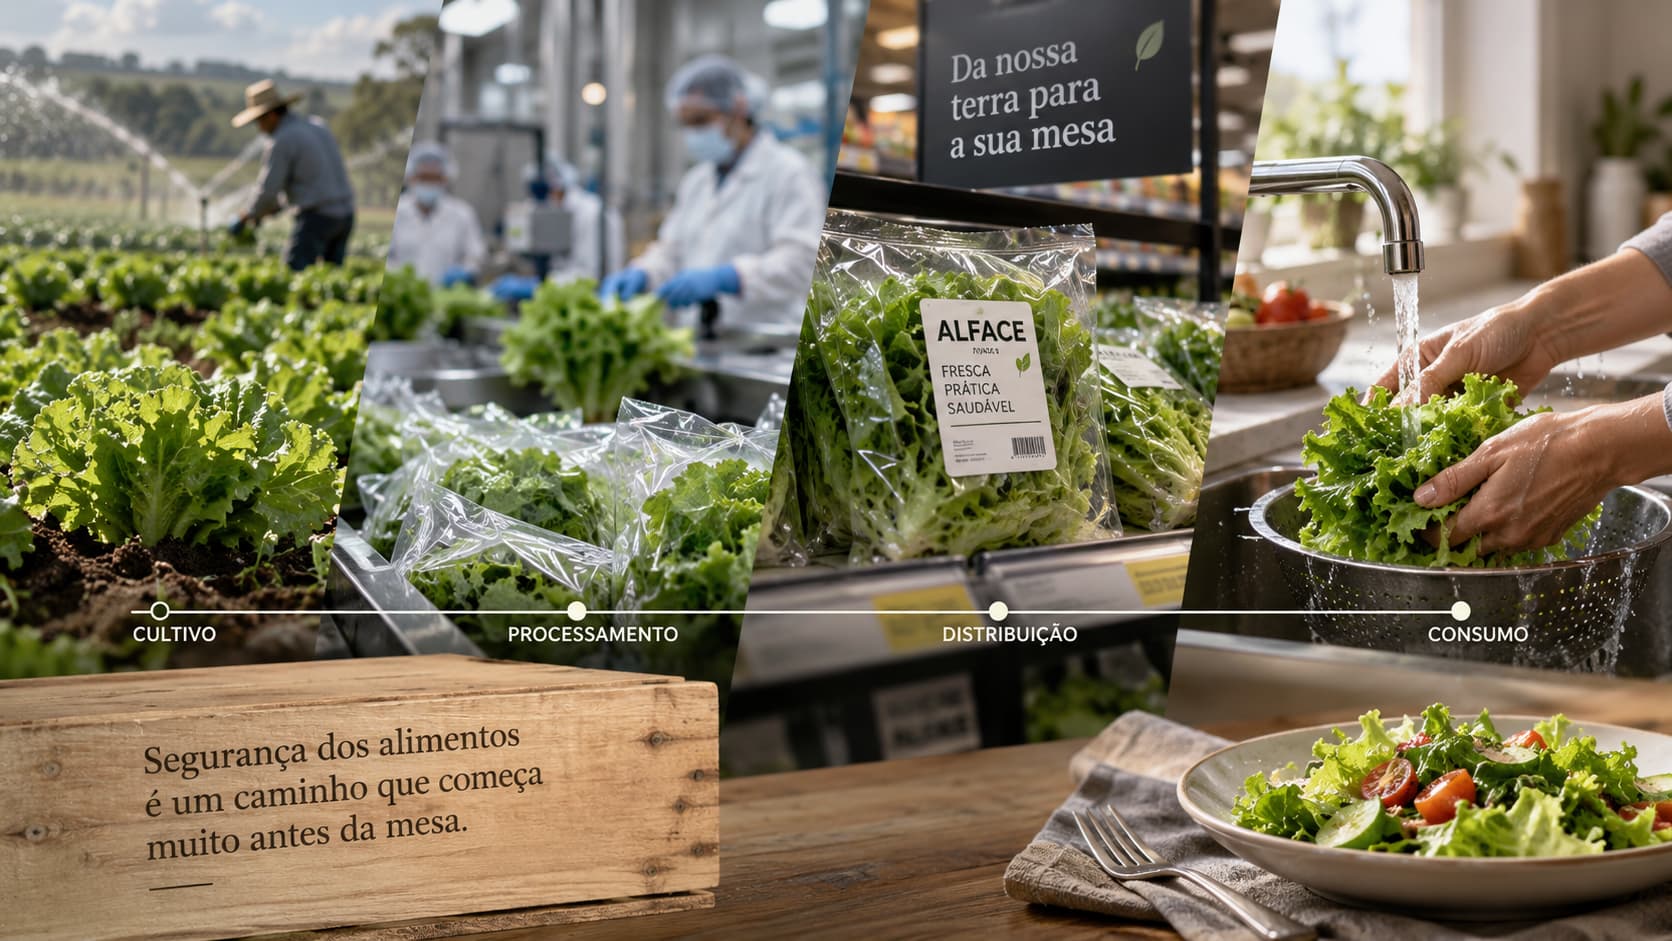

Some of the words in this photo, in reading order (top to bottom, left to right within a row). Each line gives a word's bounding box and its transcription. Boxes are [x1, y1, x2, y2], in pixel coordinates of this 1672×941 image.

[950, 53, 988, 84] Da
[994, 41, 1078, 76] nossa
[950, 90, 1020, 121] terra
[1028, 78, 1101, 120] para
[950, 136, 966, 160] a
[973, 130, 1023, 157] sua
[1031, 118, 1117, 152] mesa
[937, 319, 1027, 342] ALFACE
[941, 364, 992, 378] FRESCA
[944, 379, 1001, 396] PRÁTICA
[947, 396, 1016, 415] SAUDÁVEL
[144, 743, 308, 780] Segurança
[317, 732, 369, 761] dos
[379, 726, 520, 756] alimentos
[145, 789, 162, 818] é
[171, 792, 225, 817] um
[234, 774, 368, 810] caminho
[377, 776, 430, 807] que
[439, 767, 544, 794] começa
[146, 828, 240, 861] muito
[250, 824, 330, 852] antes
[340, 814, 377, 842] da
[386, 814, 468, 839] mesa.
